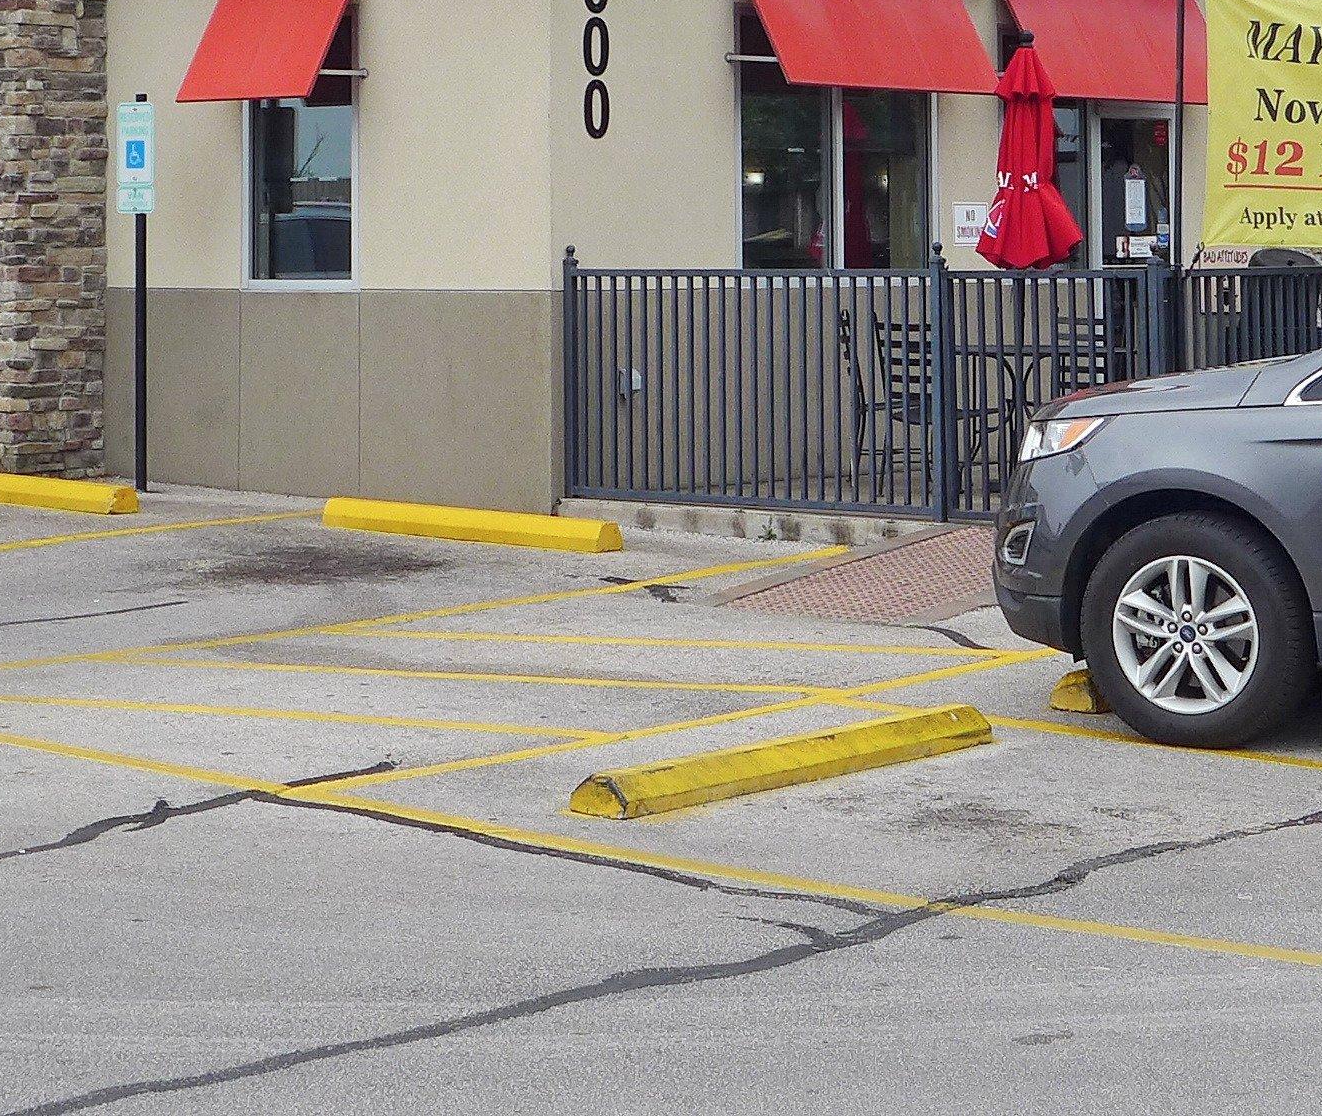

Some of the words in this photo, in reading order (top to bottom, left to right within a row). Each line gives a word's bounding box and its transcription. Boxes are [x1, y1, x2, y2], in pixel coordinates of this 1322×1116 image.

[1226, 136, 1304, 181] $12
[965, 209, 976, 222] NO
[1239, 206, 1298, 231] Apply
